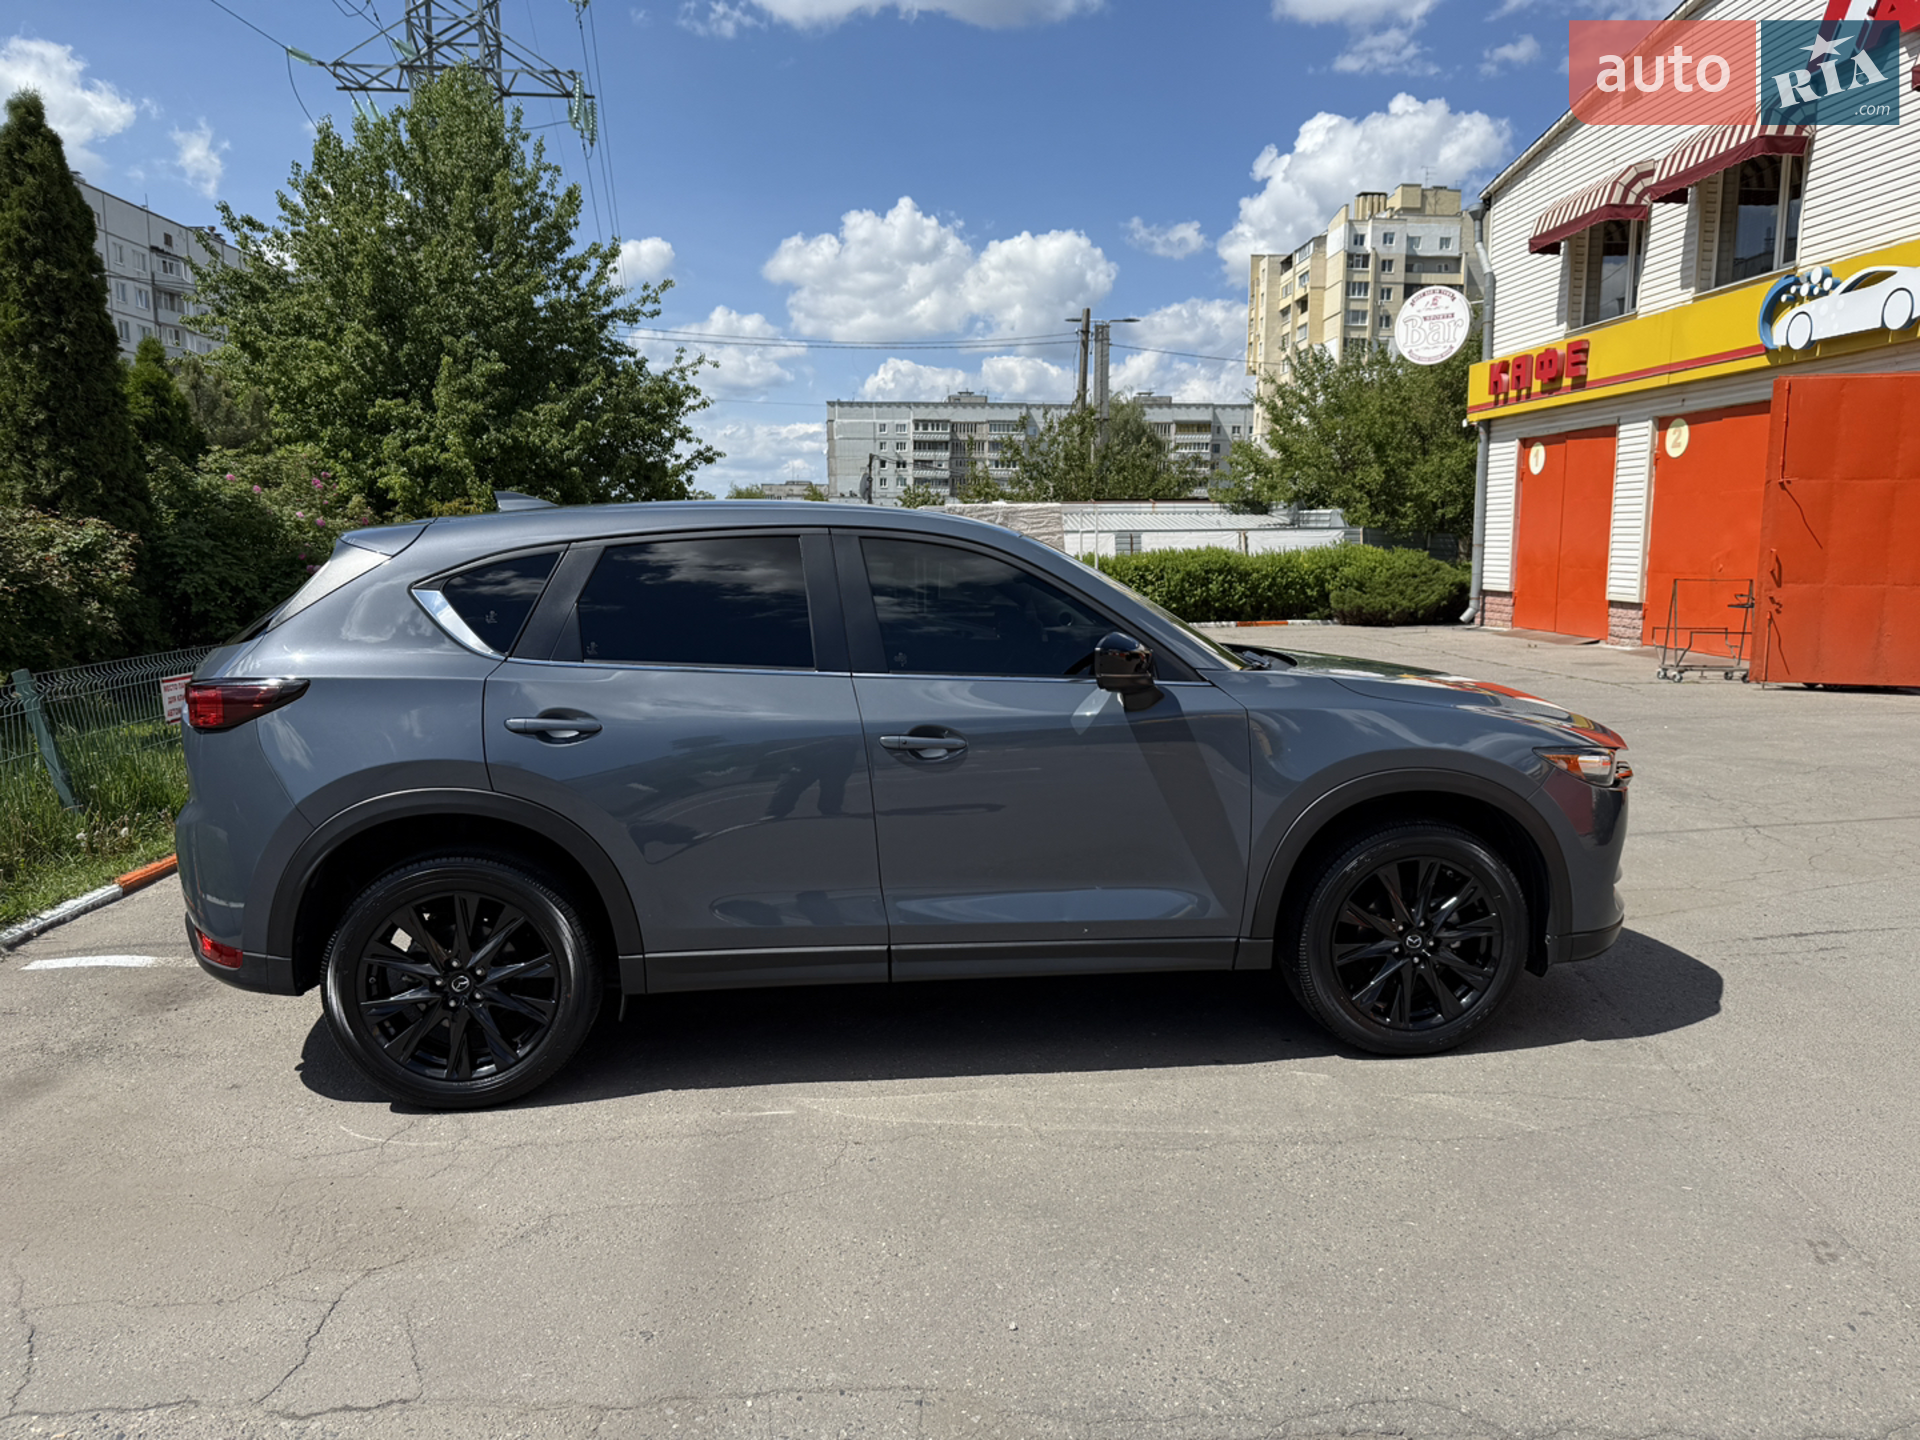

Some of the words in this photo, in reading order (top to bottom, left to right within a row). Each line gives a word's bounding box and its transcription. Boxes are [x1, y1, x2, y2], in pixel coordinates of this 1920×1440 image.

[1402, 315, 1464, 348] Bar
[1488, 339, 1590, 396] КАФЕ
[1671, 426, 1683, 449] 2
